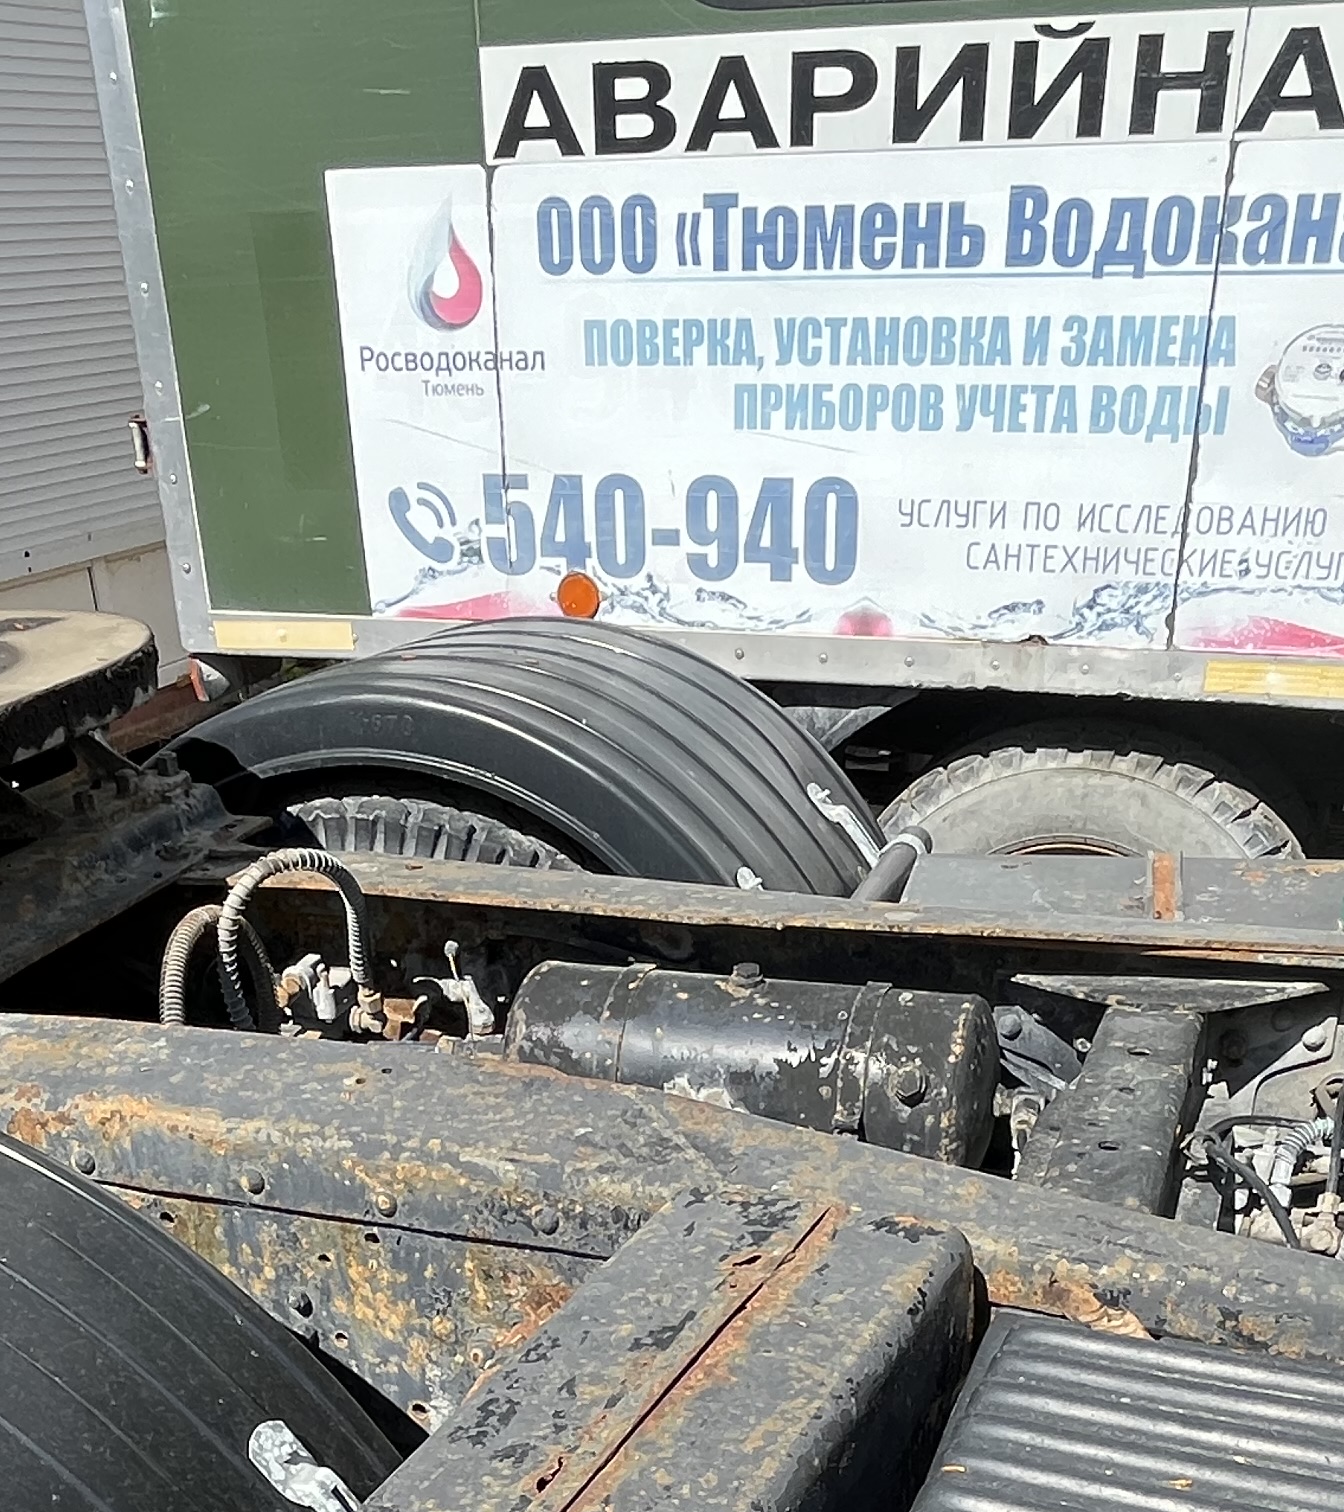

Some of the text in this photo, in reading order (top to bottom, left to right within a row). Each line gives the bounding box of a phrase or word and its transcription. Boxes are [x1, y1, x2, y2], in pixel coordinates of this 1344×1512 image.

[536, 194, 657, 276] ООО
[675, 192, 986, 274] «Тюмень
[359, 345, 546, 377] Росводоканал
[583, 315, 1237, 372] ПОВЕРКА, УСТАНОВКА И ЗАМЕНА
[421, 379, 485, 397] Тюмень
[733, 382, 1231, 444] ПРИБОРОВ УЧЕТА ВОДЫ
[482, 472, 859, 586] 540-940
[898, 498, 1007, 530] УСЛУГИ
[1023, 501, 1061, 532] ПО
[1076, 503, 1328, 539] ИССЛЕДОВАНИЮ
[966, 541, 1237, 579] САНТЕХНИЧЕСКИЕ
